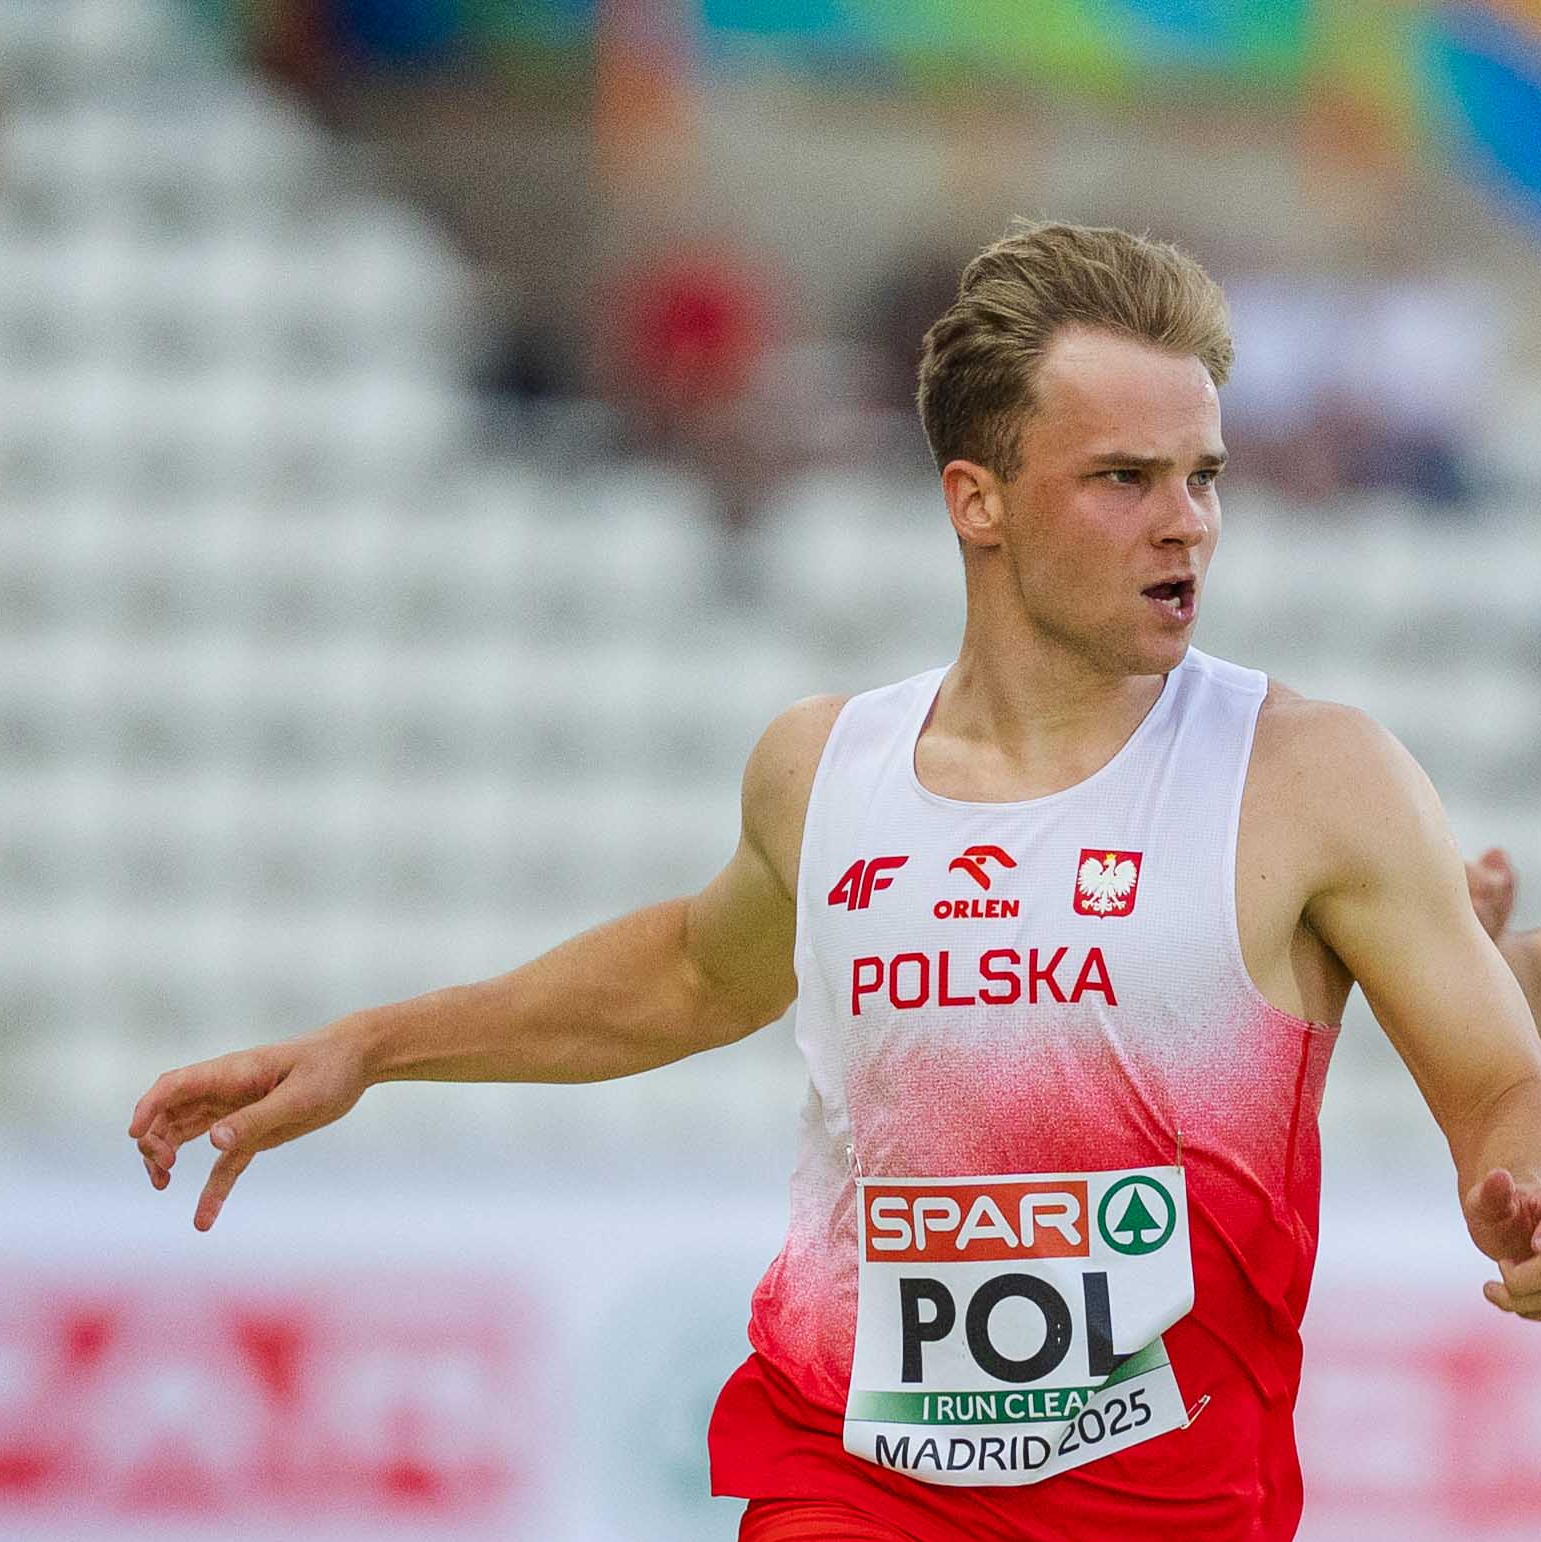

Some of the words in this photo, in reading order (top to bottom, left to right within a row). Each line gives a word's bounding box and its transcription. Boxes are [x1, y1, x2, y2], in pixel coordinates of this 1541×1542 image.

[828, 856, 909, 911] 4F
[934, 900, 1020, 919] ORLEN
[851, 947, 1118, 1015] POLSKA
[870, 1192, 1082, 1251] SPAR
[899, 1272, 1134, 1383] POL
[875, 1434, 1051, 1471] MADRID
[1058, 1388, 1152, 1456] 2025
[922, 1396, 930, 1420] I
[936, 1395, 998, 1421] RUN
[1004, 1390, 1096, 1419] CLEA
